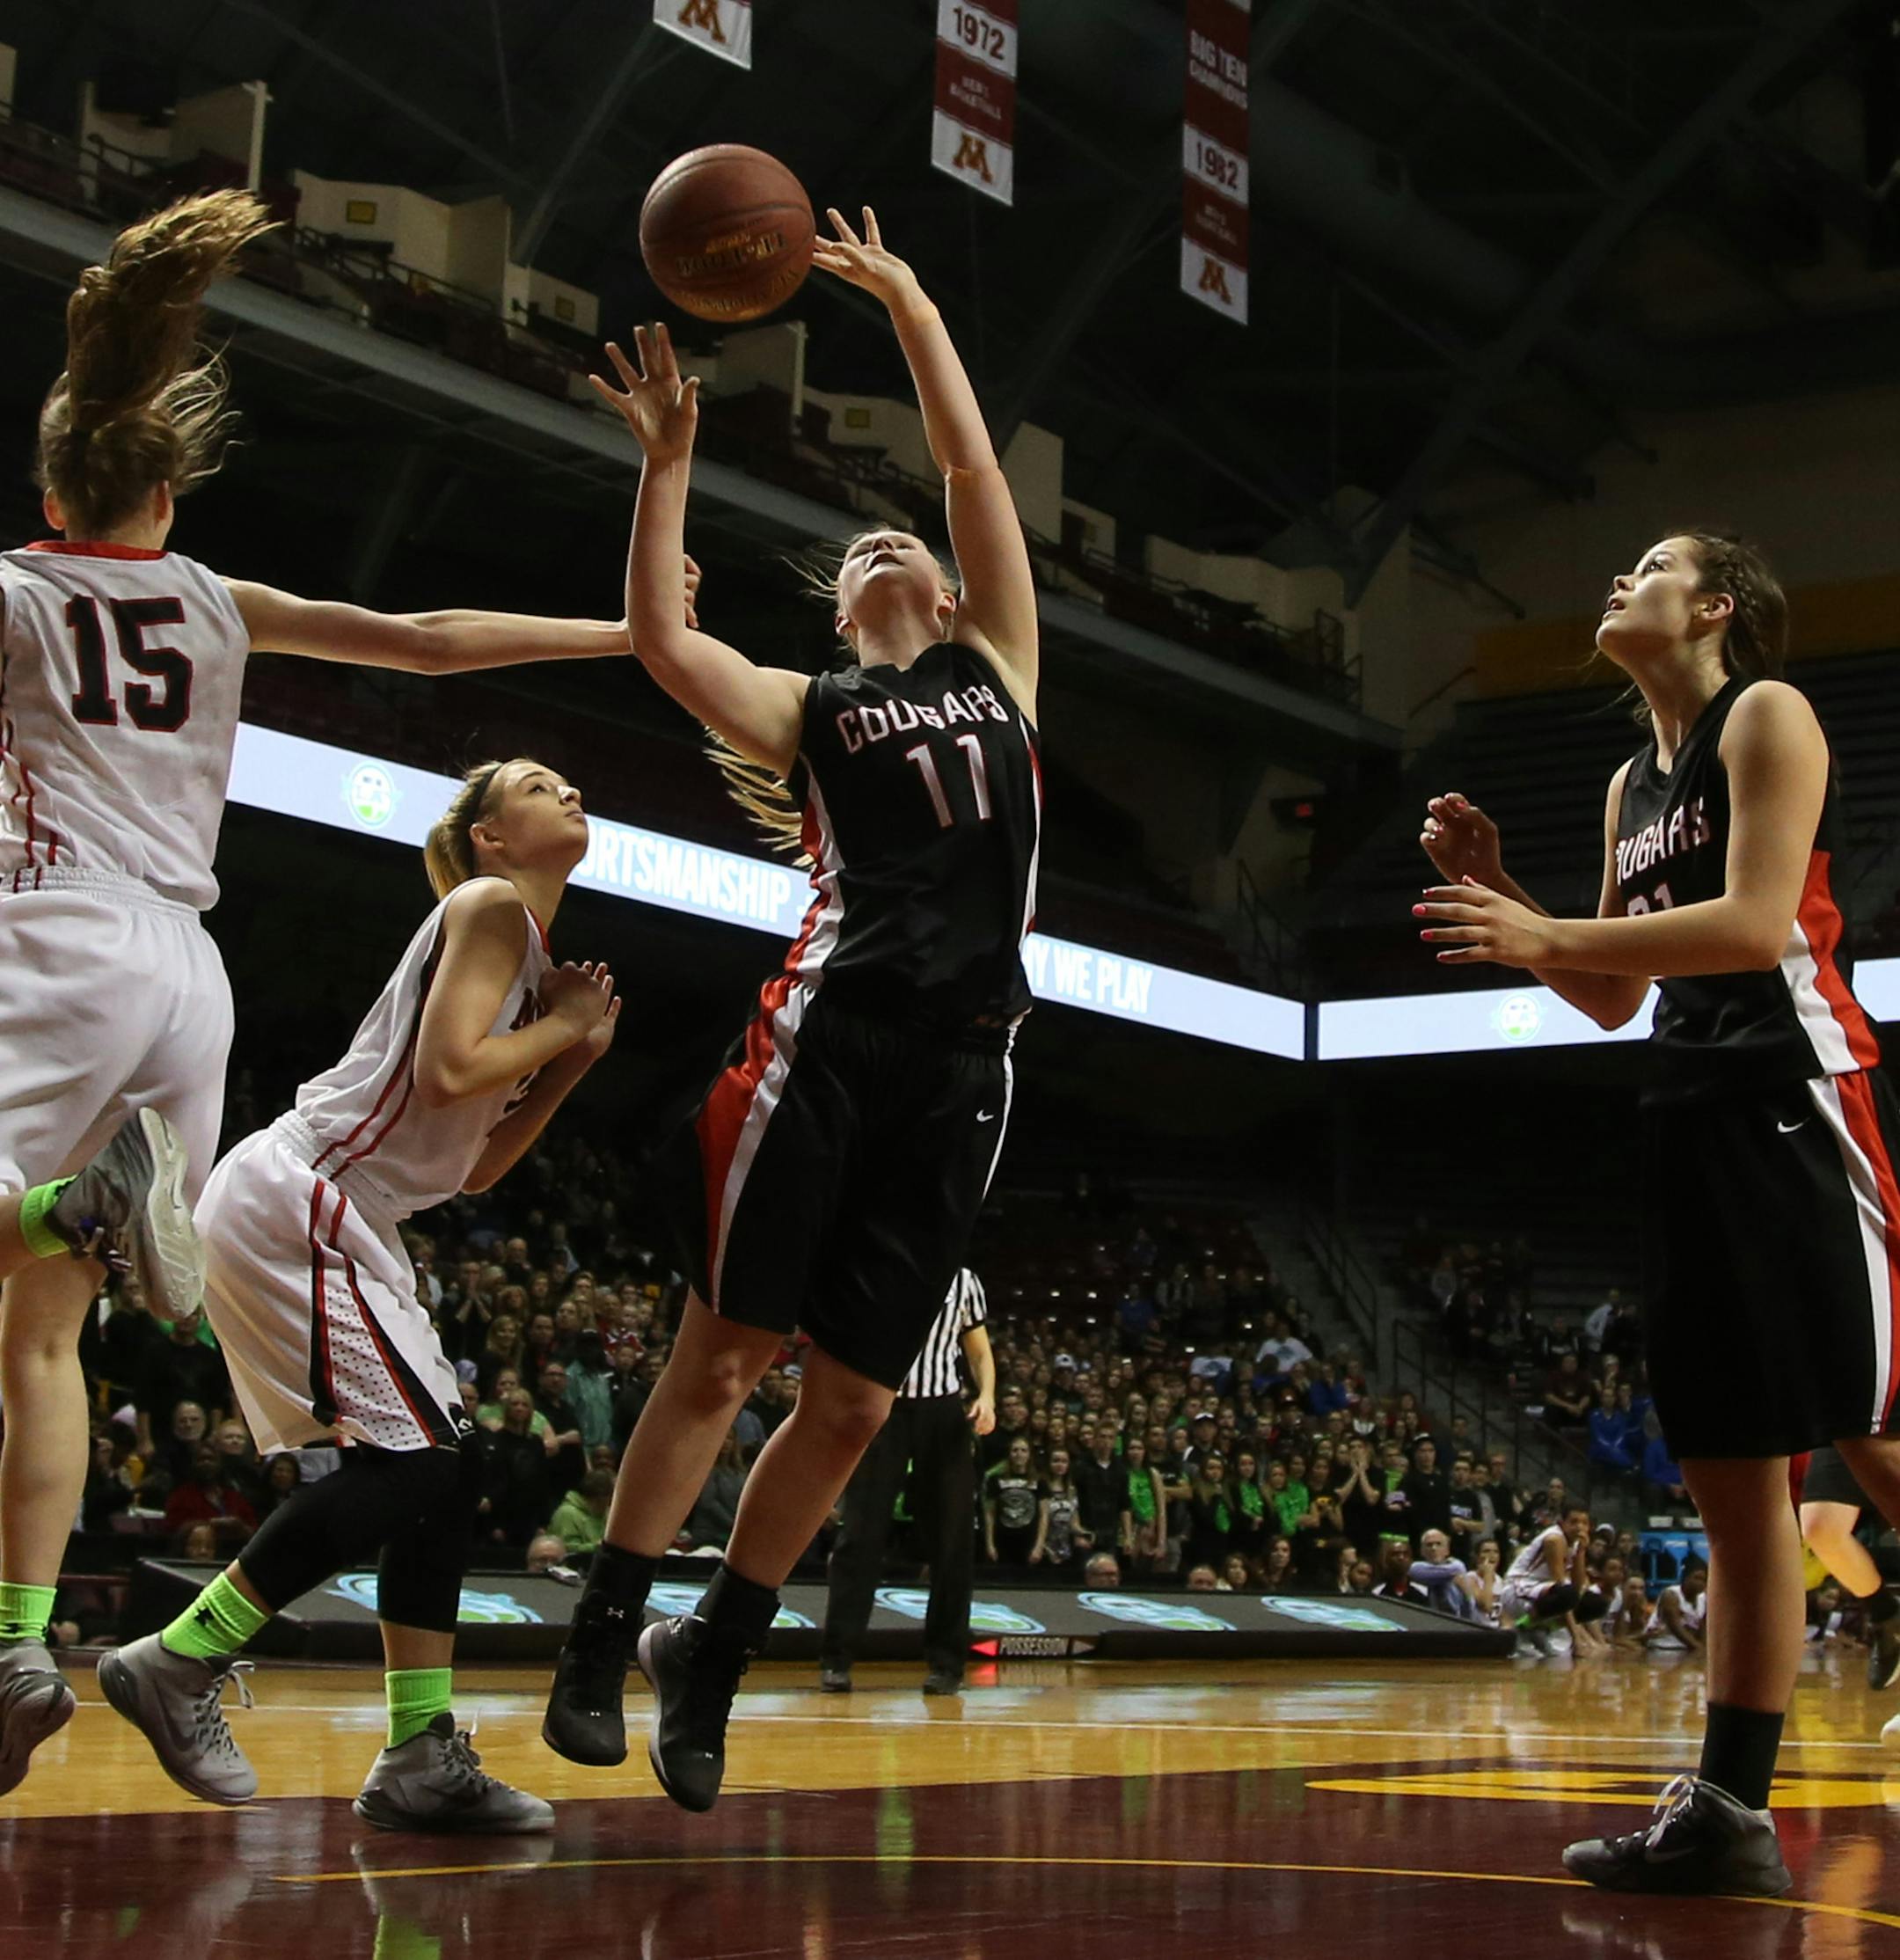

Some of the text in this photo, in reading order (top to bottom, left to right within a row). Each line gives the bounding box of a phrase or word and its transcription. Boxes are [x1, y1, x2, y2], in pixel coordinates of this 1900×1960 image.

[953, 5, 1005, 60] 1972
[1196, 141, 1238, 190] 1982
[65, 593, 194, 733] 15
[837, 684, 1010, 754] COUGARS
[905, 733, 992, 829] 11
[1053, 944, 1092, 1000] WE
[1096, 955, 1153, 1014] PLAY
